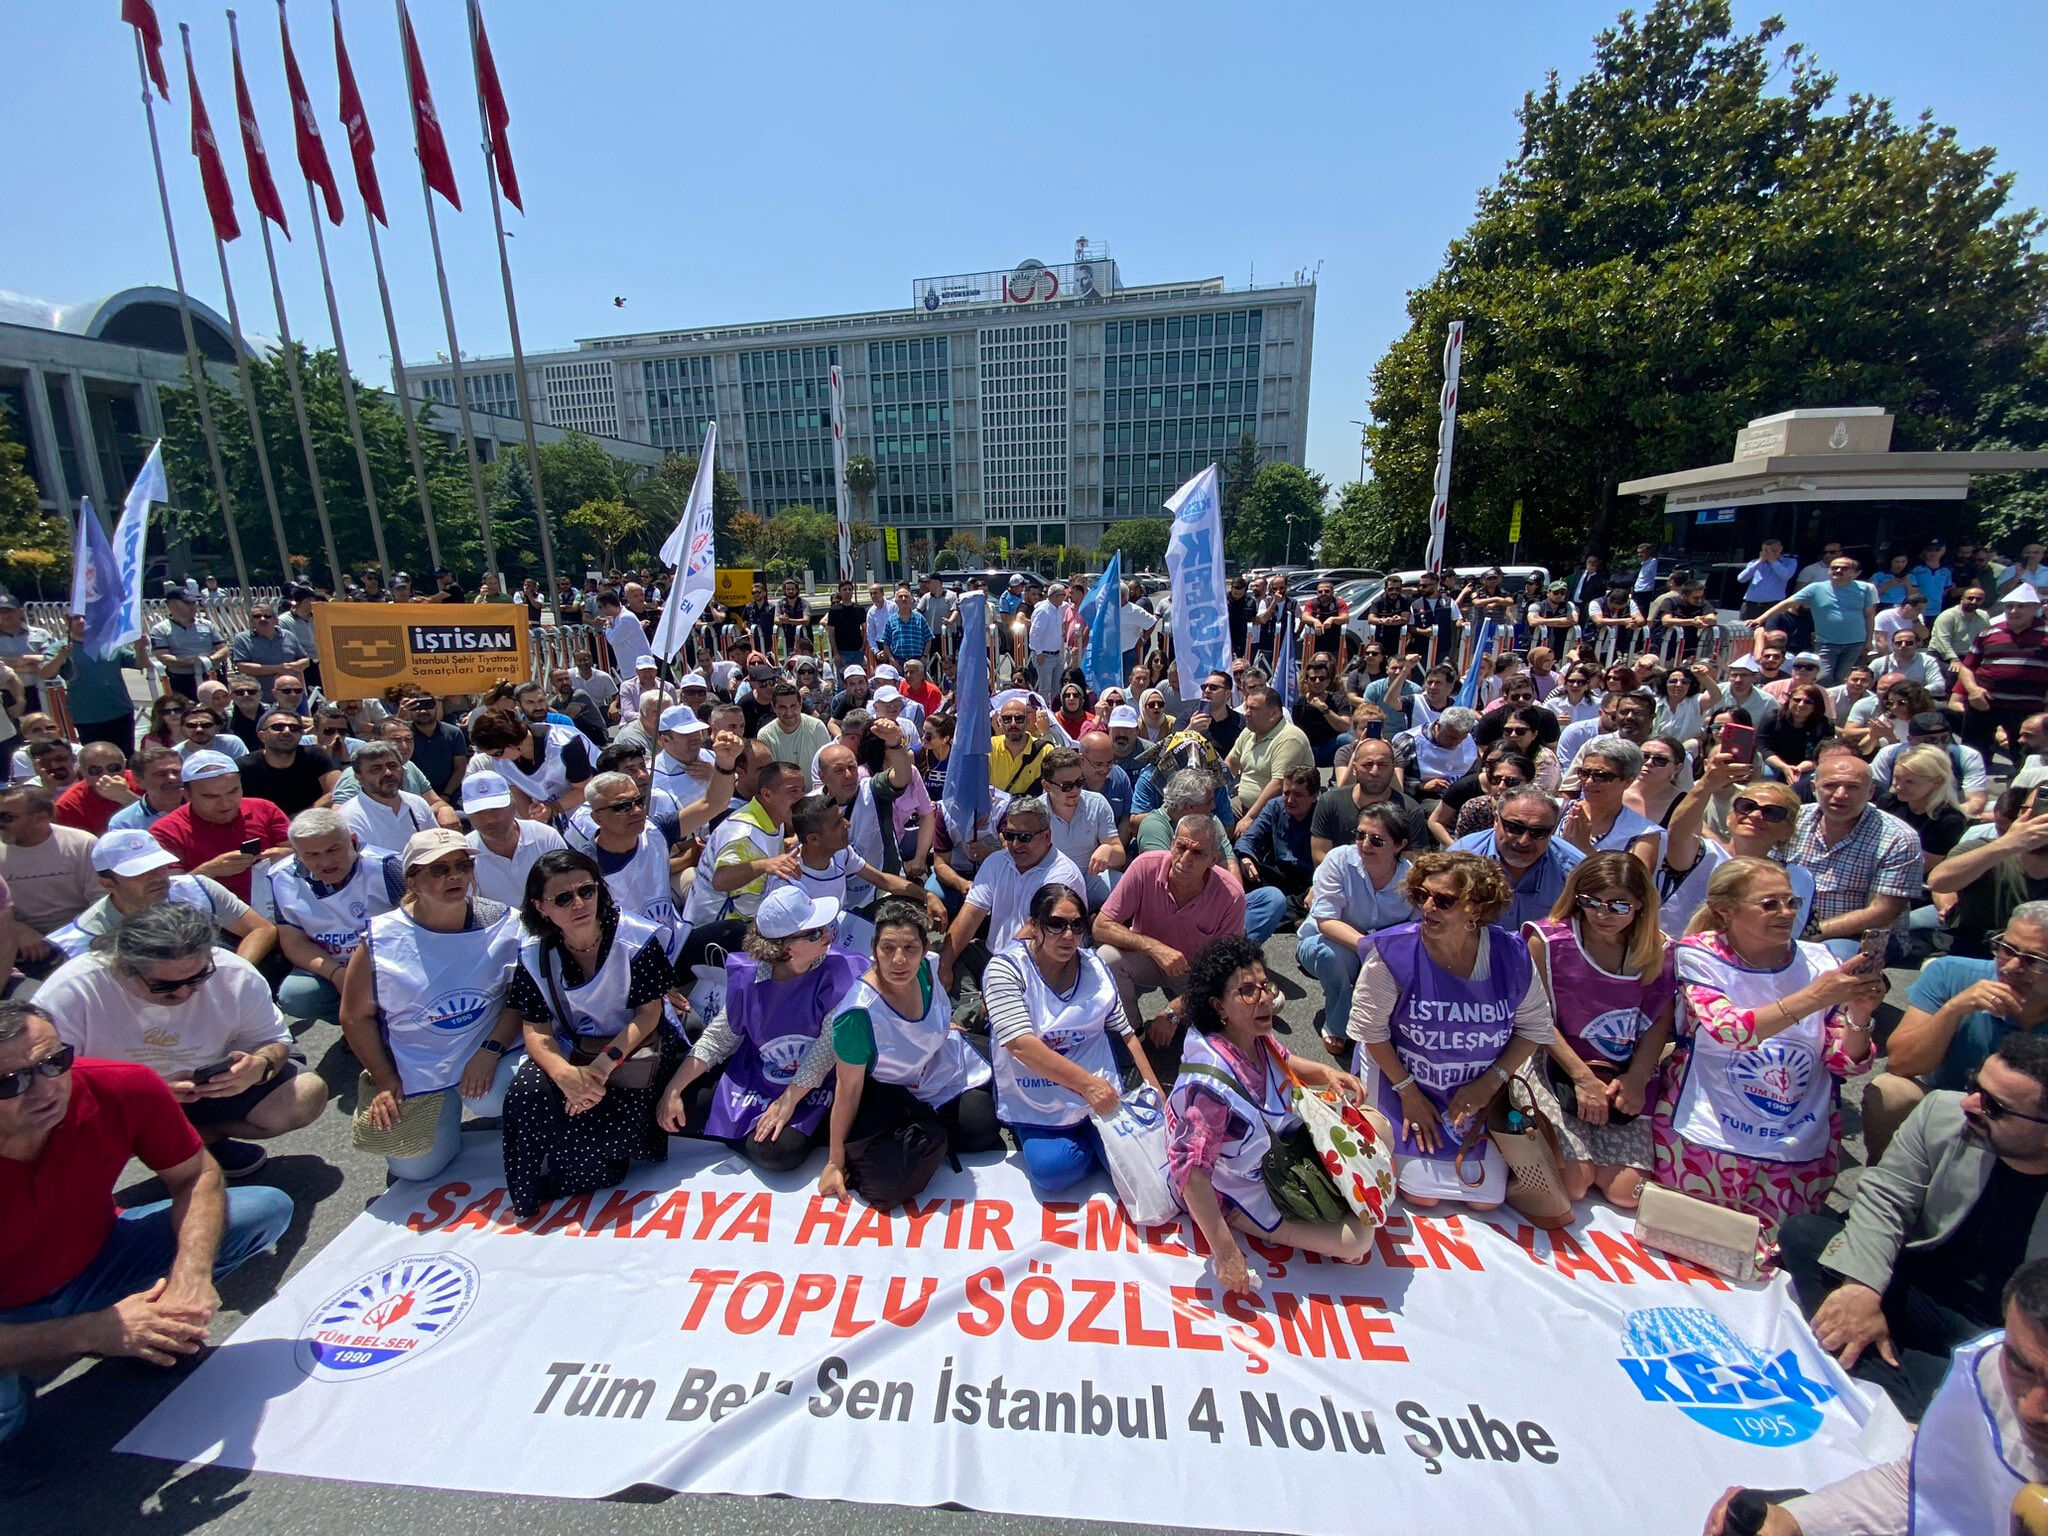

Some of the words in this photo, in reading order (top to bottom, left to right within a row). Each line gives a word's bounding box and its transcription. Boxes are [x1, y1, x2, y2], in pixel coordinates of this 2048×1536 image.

[414, 627, 512, 653] İSTİSAN
[411, 654, 450, 665] İstanbul
[451, 654, 476, 666] Şehir
[478, 654, 519, 665] Tiyatrosu
[412, 665, 474, 677] Sanatçıları
[477, 665, 520, 675] Derneği
[450, 1013, 474, 1025] 1990
[1408, 993, 1515, 1024] İSTANBUL
[1765, 1100, 1792, 1112] 1990
[793, 1196, 1014, 1251] HAYIR
[1041, 1200, 1486, 1279] EMEÇEN
[680, 1267, 940, 1338] TOPLU
[956, 1259, 1411, 1374] SÖZLEŞME
[313, 1329, 351, 1345] TÜM
[351, 1336, 419, 1350] BEL-SEN
[333, 1350, 374, 1364] 1990
[1616, 1348, 1838, 1407] KESK
[533, 1361, 657, 1420] Tüm
[932, 1355, 1169, 1441] İstanbul
[1188, 1386, 1225, 1445] 4
[1241, 1391, 1386, 1456] Nolu
[1399, 1399, 1561, 1475] Şube
[1732, 1414, 1797, 1439] 1995
